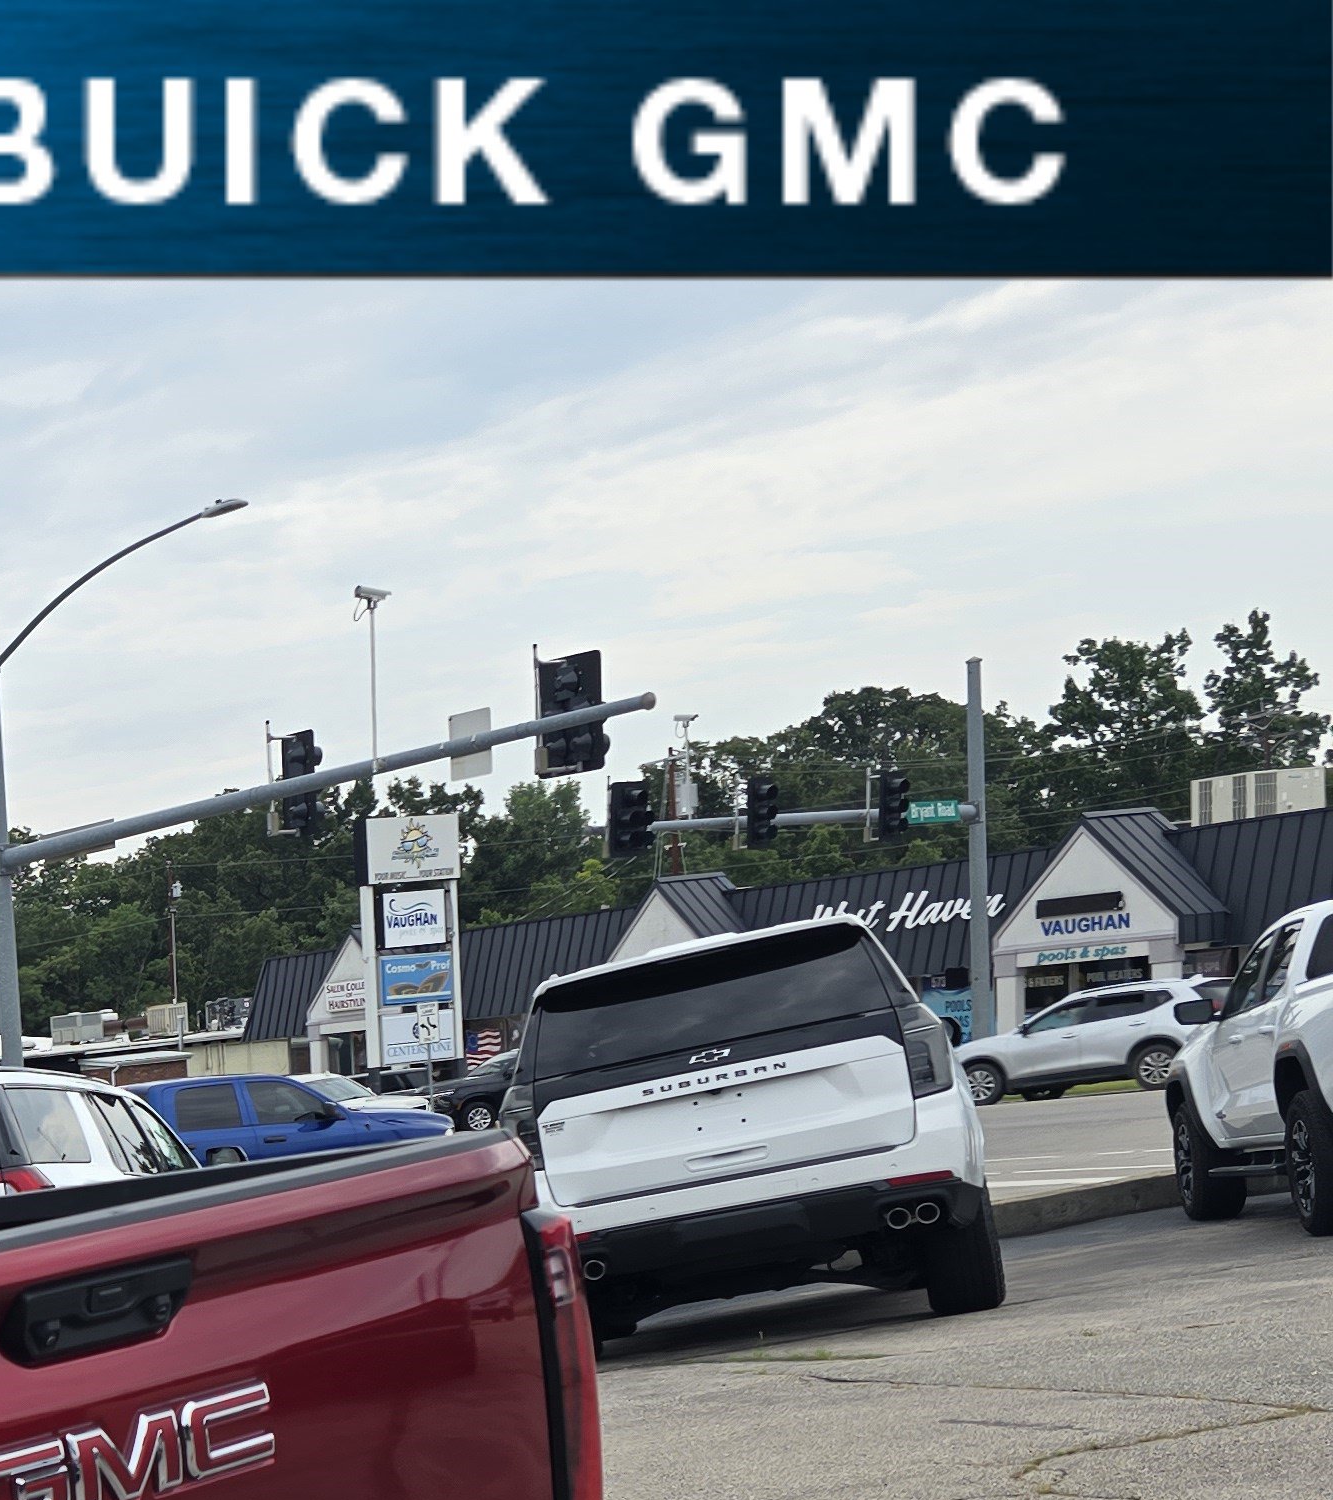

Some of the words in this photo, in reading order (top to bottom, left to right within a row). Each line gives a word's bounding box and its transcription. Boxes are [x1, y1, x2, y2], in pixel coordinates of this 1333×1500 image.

[911, 803, 935, 821] Bryant
[937, 802, 955, 817] Road
[386, 913, 438, 928] VAUGHAN
[812, 900, 886, 929] Wst
[1040, 913, 1131, 937] VAUGHAN
[1037, 948, 1076, 965] pools
[1079, 946, 1091, 958] &
[1093, 944, 1128, 960] spas
[385, 962, 416, 974] Cosmo
[430, 959, 450, 970] Prof
[642, 1062, 787, 1097] SUBURBAN
